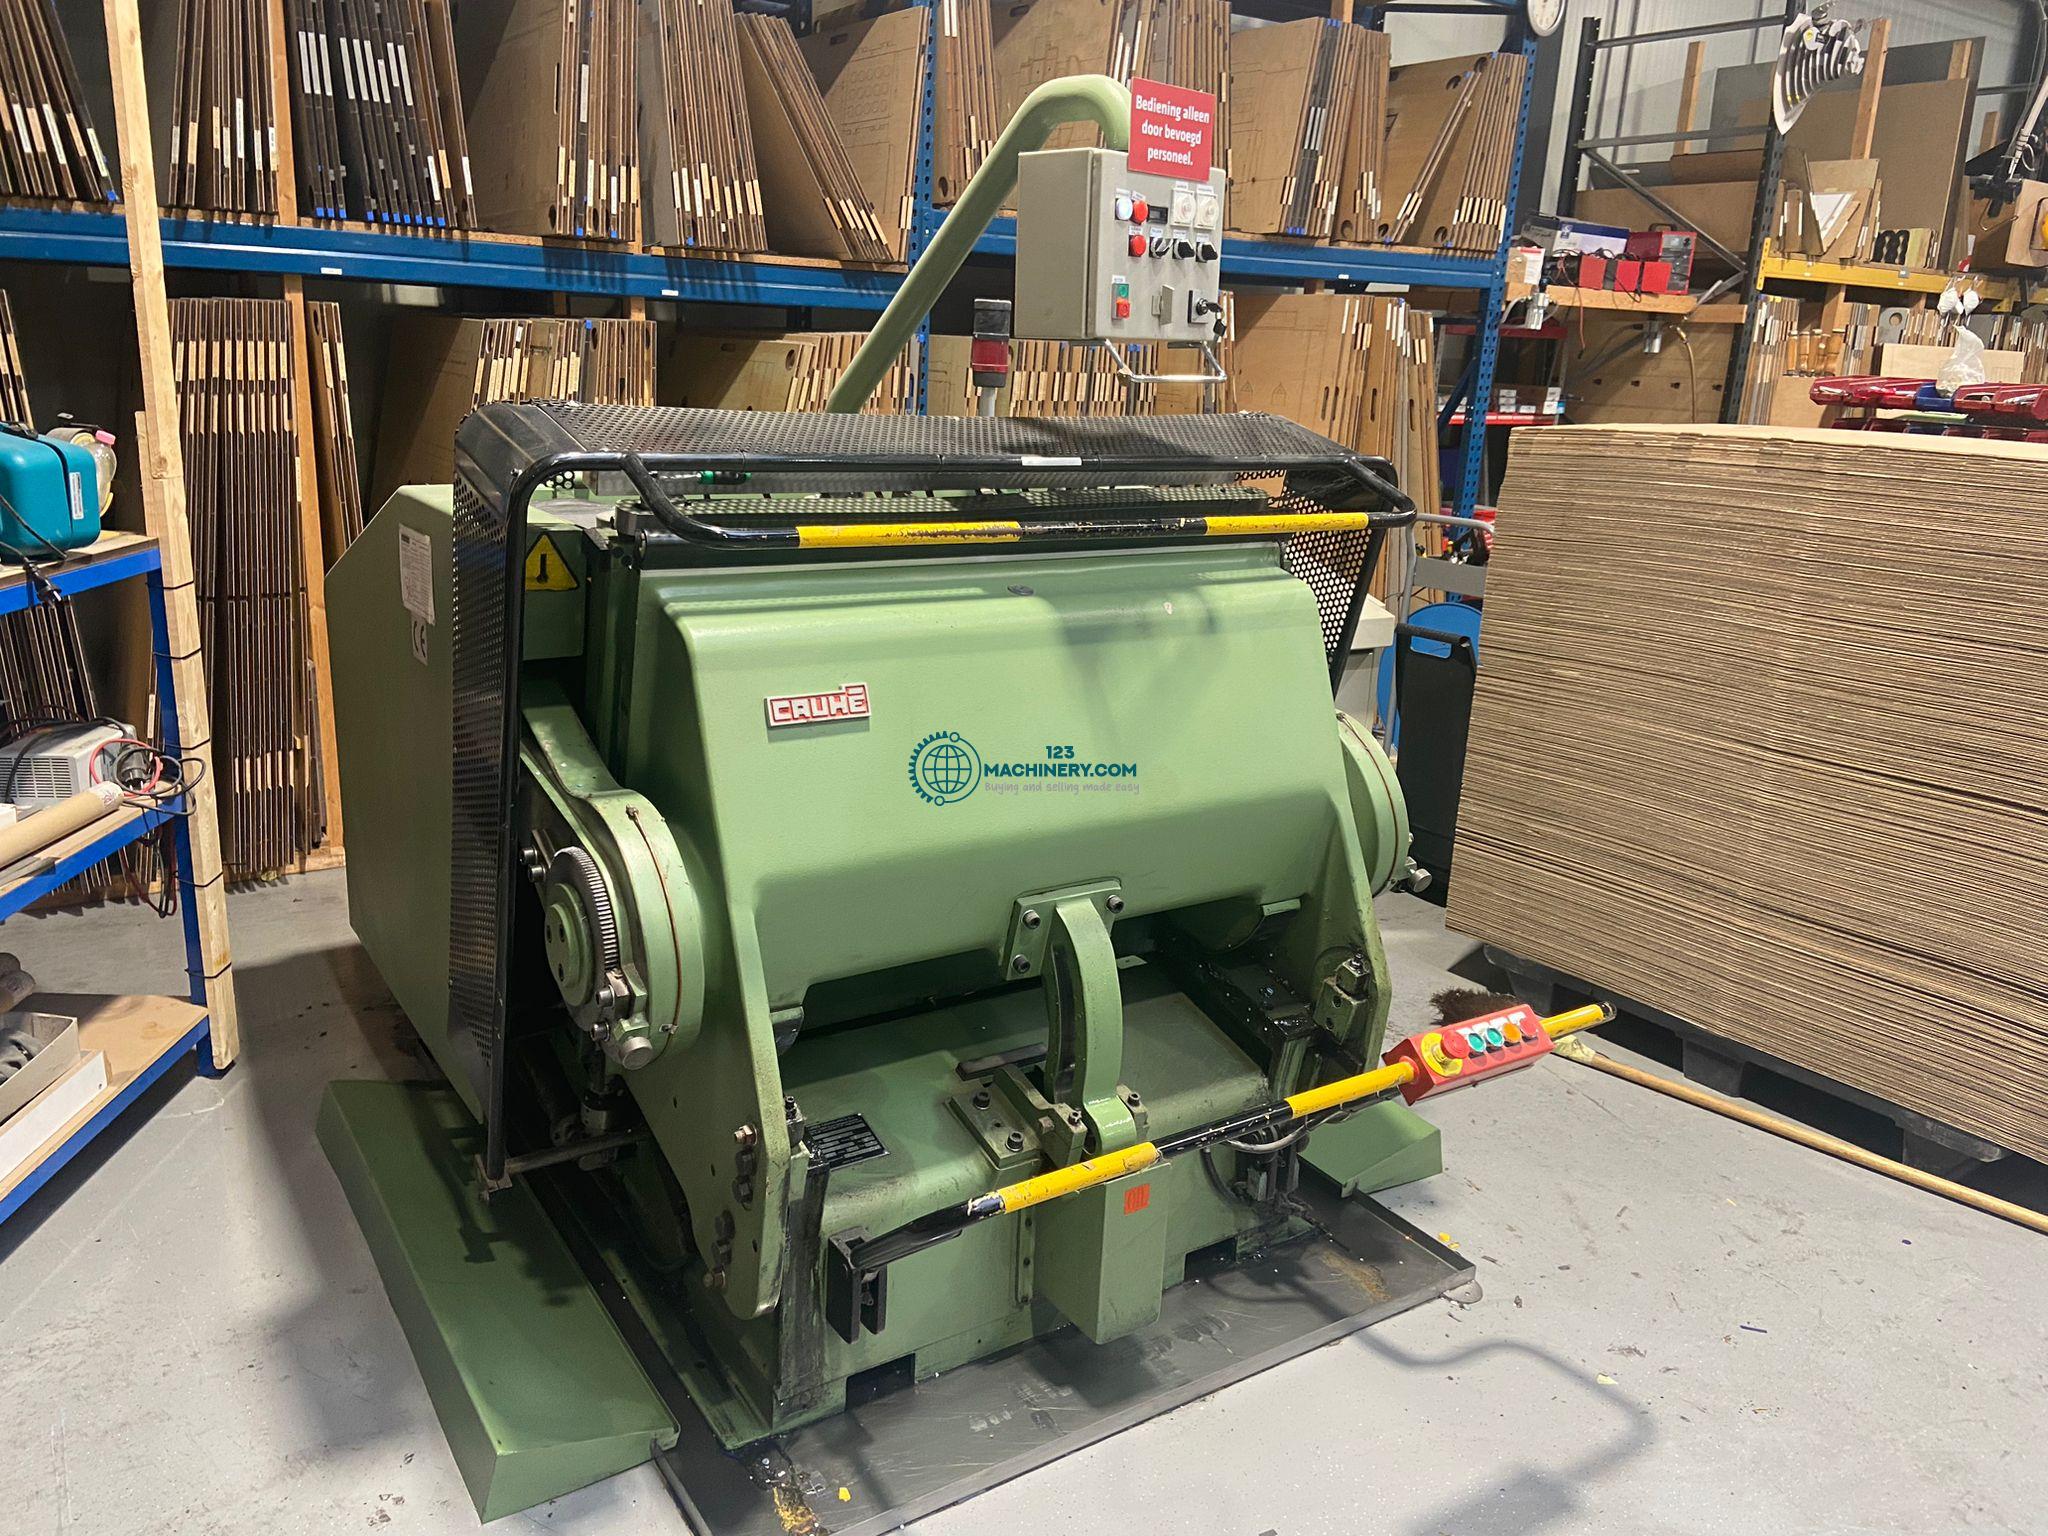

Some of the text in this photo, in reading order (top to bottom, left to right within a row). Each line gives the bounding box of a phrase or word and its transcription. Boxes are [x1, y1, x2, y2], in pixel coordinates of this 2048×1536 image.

[1135, 94, 1210, 124] Bediening alleen
[1141, 119, 1202, 148] door bevoegd
[1147, 147, 1194, 166] personeel.
